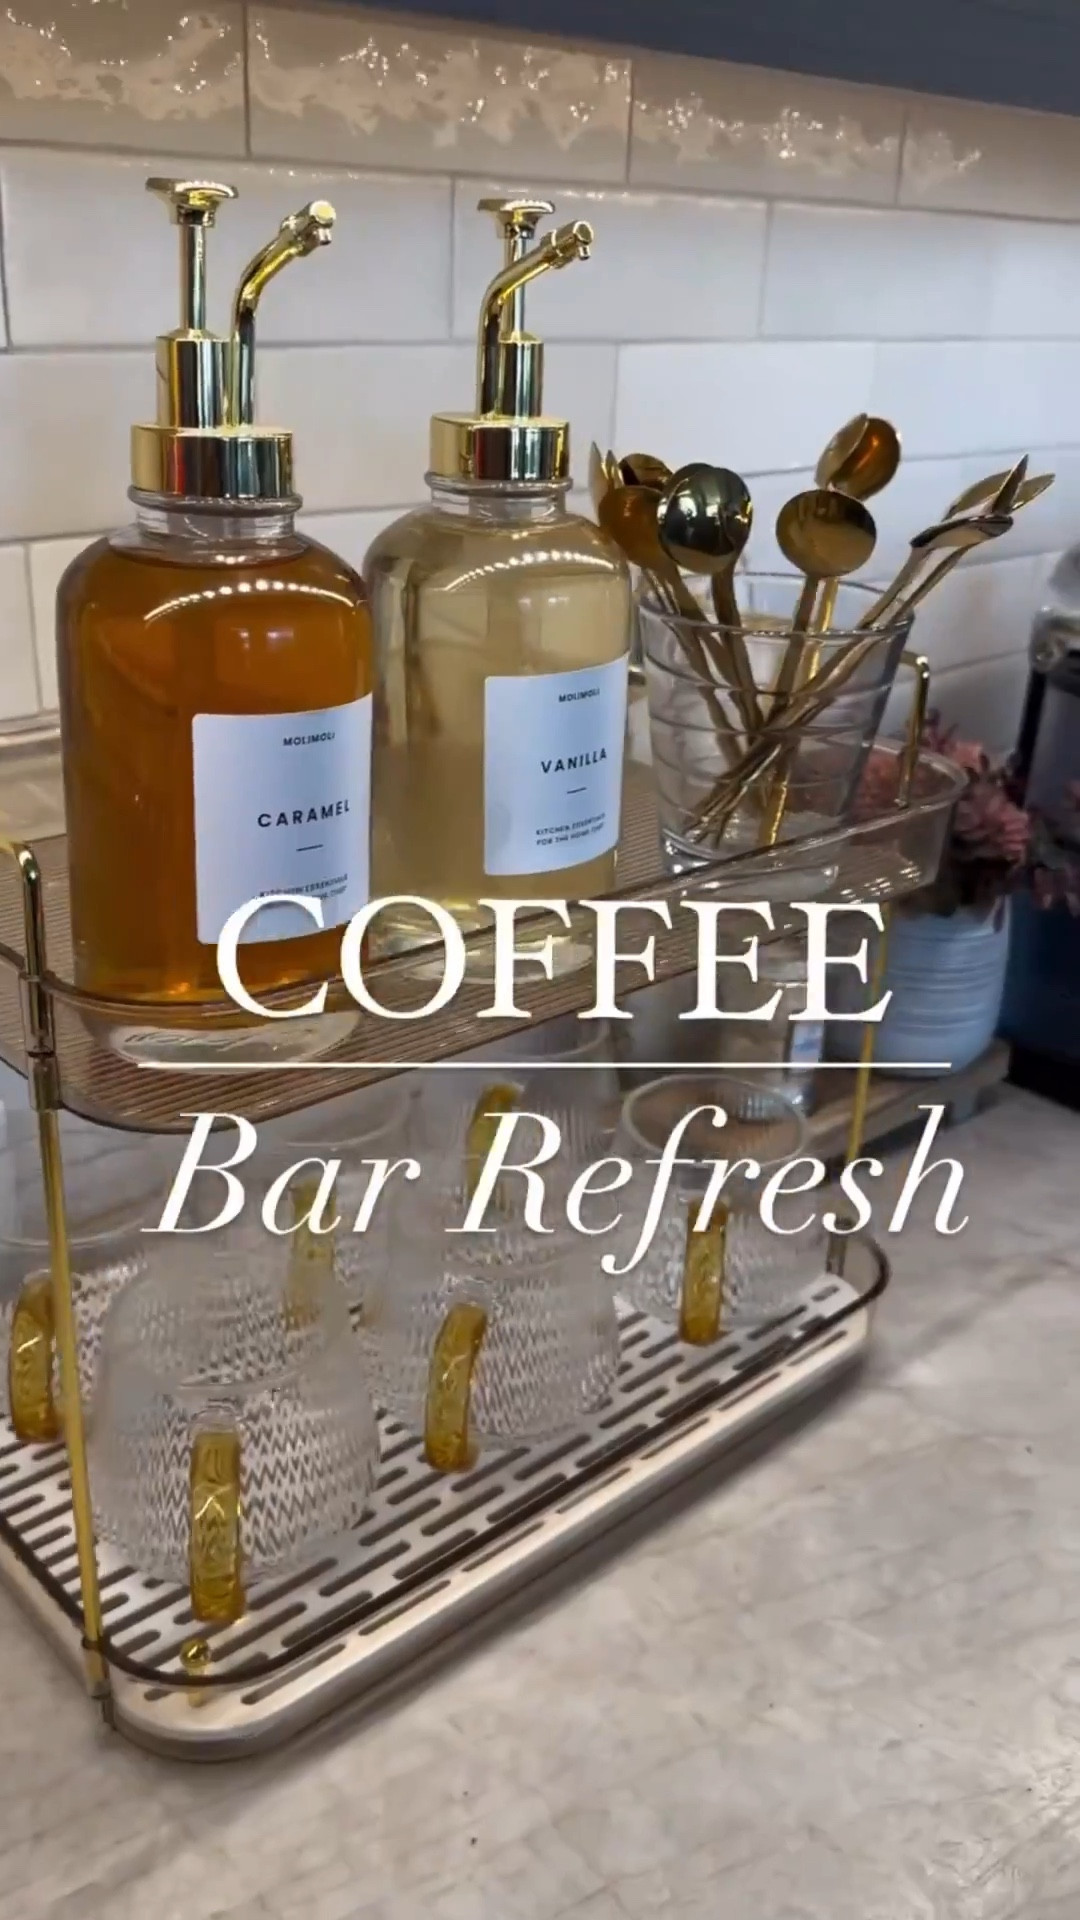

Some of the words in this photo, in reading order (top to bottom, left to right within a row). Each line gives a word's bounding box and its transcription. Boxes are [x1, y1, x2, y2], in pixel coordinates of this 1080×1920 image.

[558, 688, 600, 703] MOLIMOLI
[283, 731, 336, 747] MOLIMOLI
[540, 747, 608, 775] VANILLA
[257, 799, 350, 829] CARAMEL
